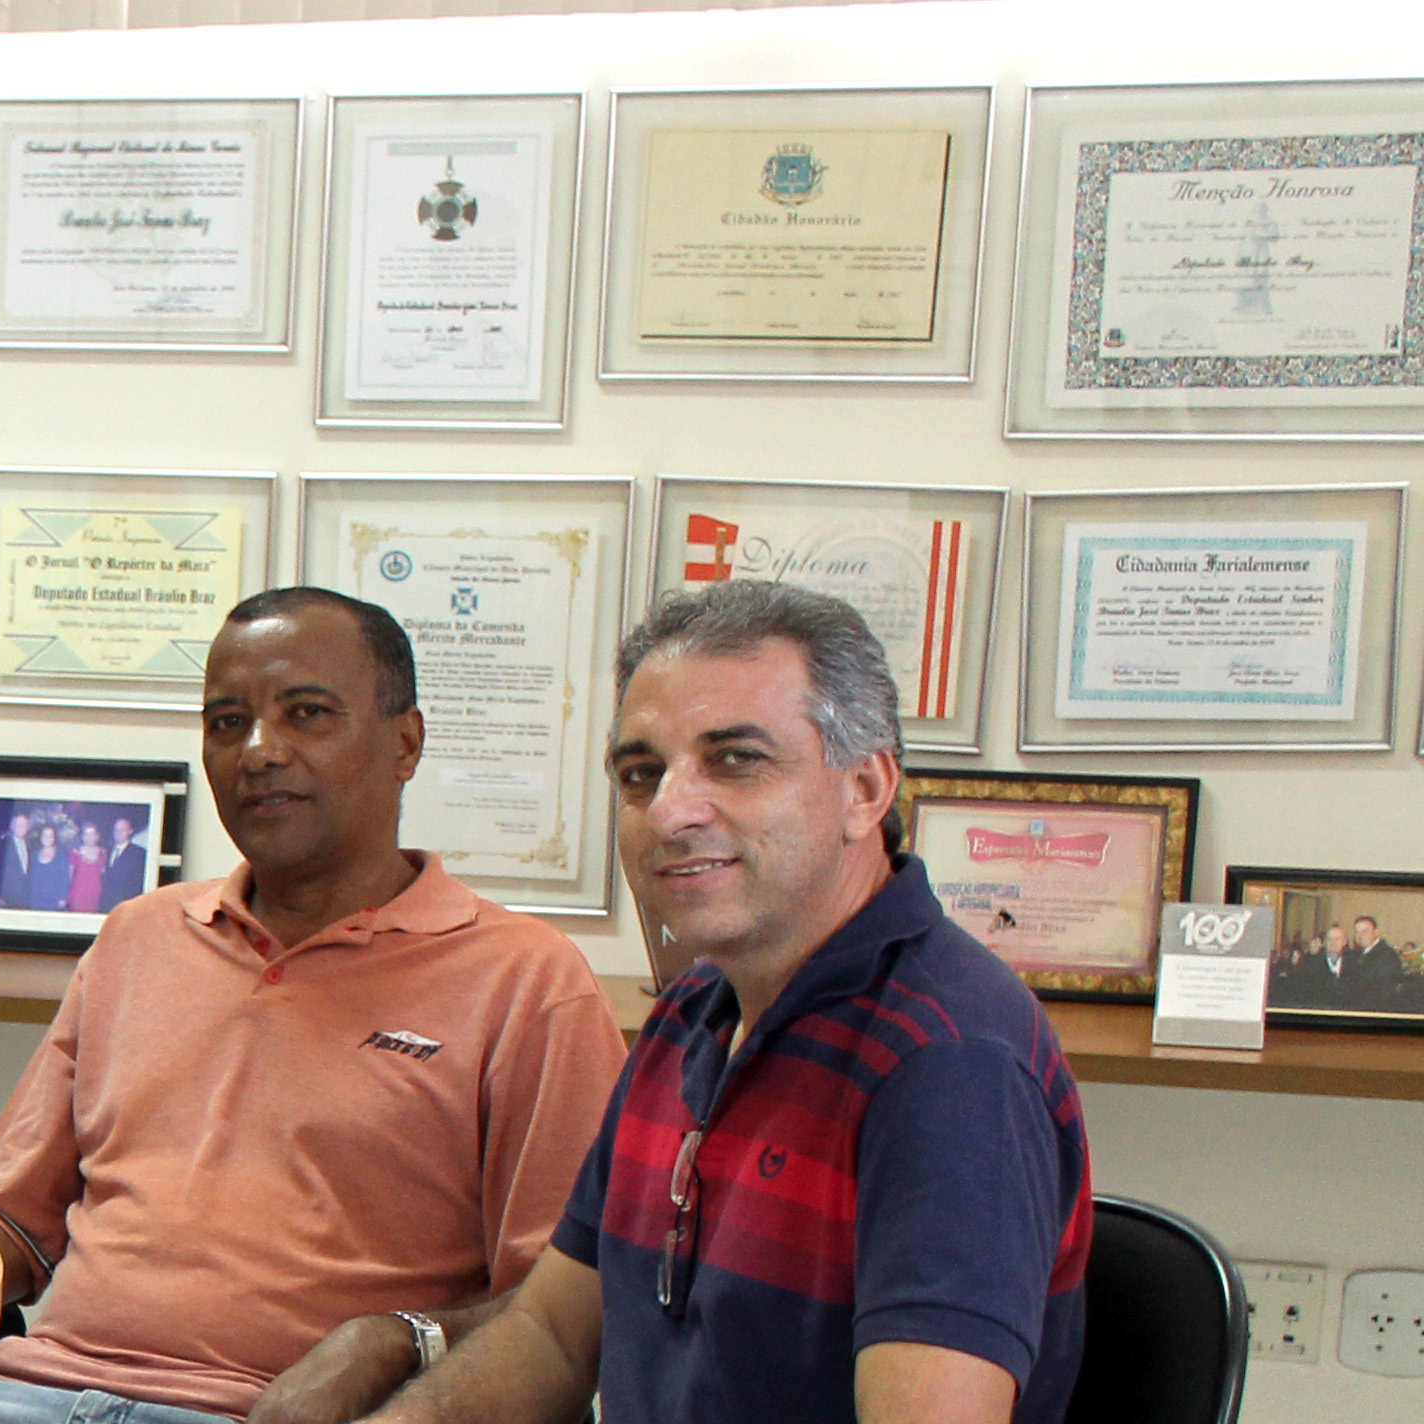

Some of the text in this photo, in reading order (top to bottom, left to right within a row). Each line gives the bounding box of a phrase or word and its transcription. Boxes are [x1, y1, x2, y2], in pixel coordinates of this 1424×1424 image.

[1171, 177, 1355, 203] Menção Honrosa
[720, 211, 778, 225] Cidadão
[41, 555, 80, 570] Jornal
[737, 536, 868, 583] Diploma
[1115, 553, 1310, 579] Cidadania Farialemense
[33, 585, 89, 601] Deputado
[92, 586, 142, 602] Estadual
[190, 589, 216, 605] Braz
[403, 618, 451, 631] Diploma
[472, 621, 525, 632] Comenda
[1179, 909, 1252, 947] 100
